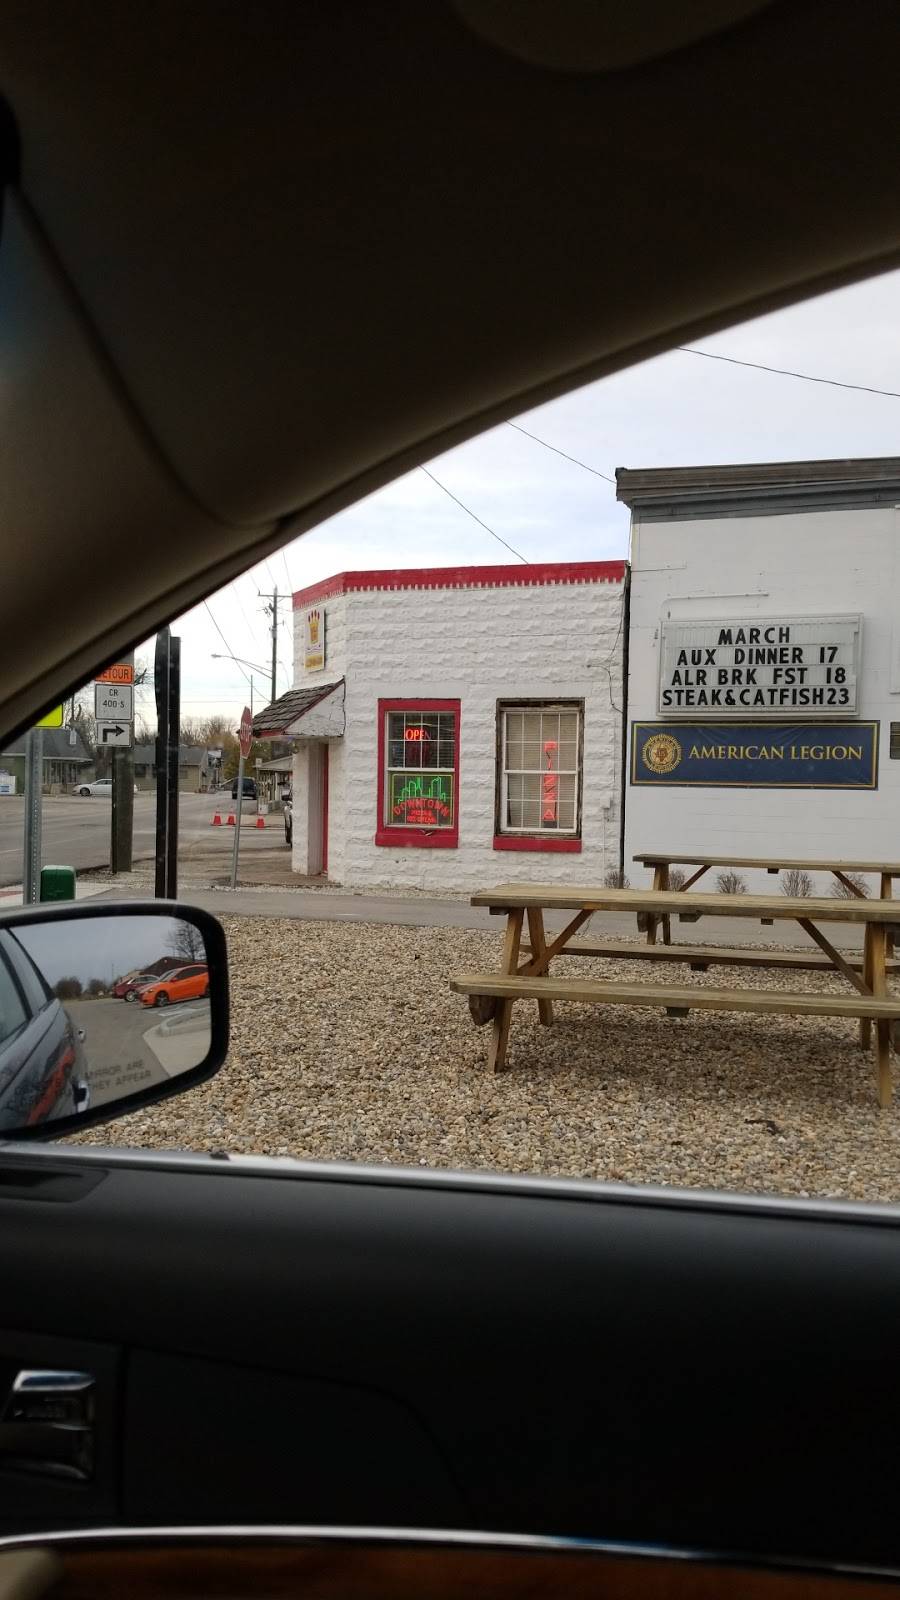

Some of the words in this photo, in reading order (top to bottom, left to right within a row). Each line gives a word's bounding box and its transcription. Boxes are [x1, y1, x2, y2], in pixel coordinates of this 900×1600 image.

[718, 627, 791, 645] MARCH
[677, 648, 717, 666] AUX
[734, 647, 803, 665] DINNER
[819, 646, 838, 663] 17
[100, 668, 129, 680] ETOUR
[671, 669, 707, 686] ALR
[718, 668, 757, 685] BRK
[773, 667, 808, 684] FST
[826, 667, 846, 684] 18
[109, 689, 118, 697] CR
[103, 700, 117, 708] 400
[120, 701, 125, 709] S
[405, 728, 432, 741] OPEN
[688, 745, 784, 760] AMERICAN
[791, 745, 863, 760] LEGION
[543, 741, 558, 822] PIZZA
[393, 798, 450, 817] DOWNTOWN
